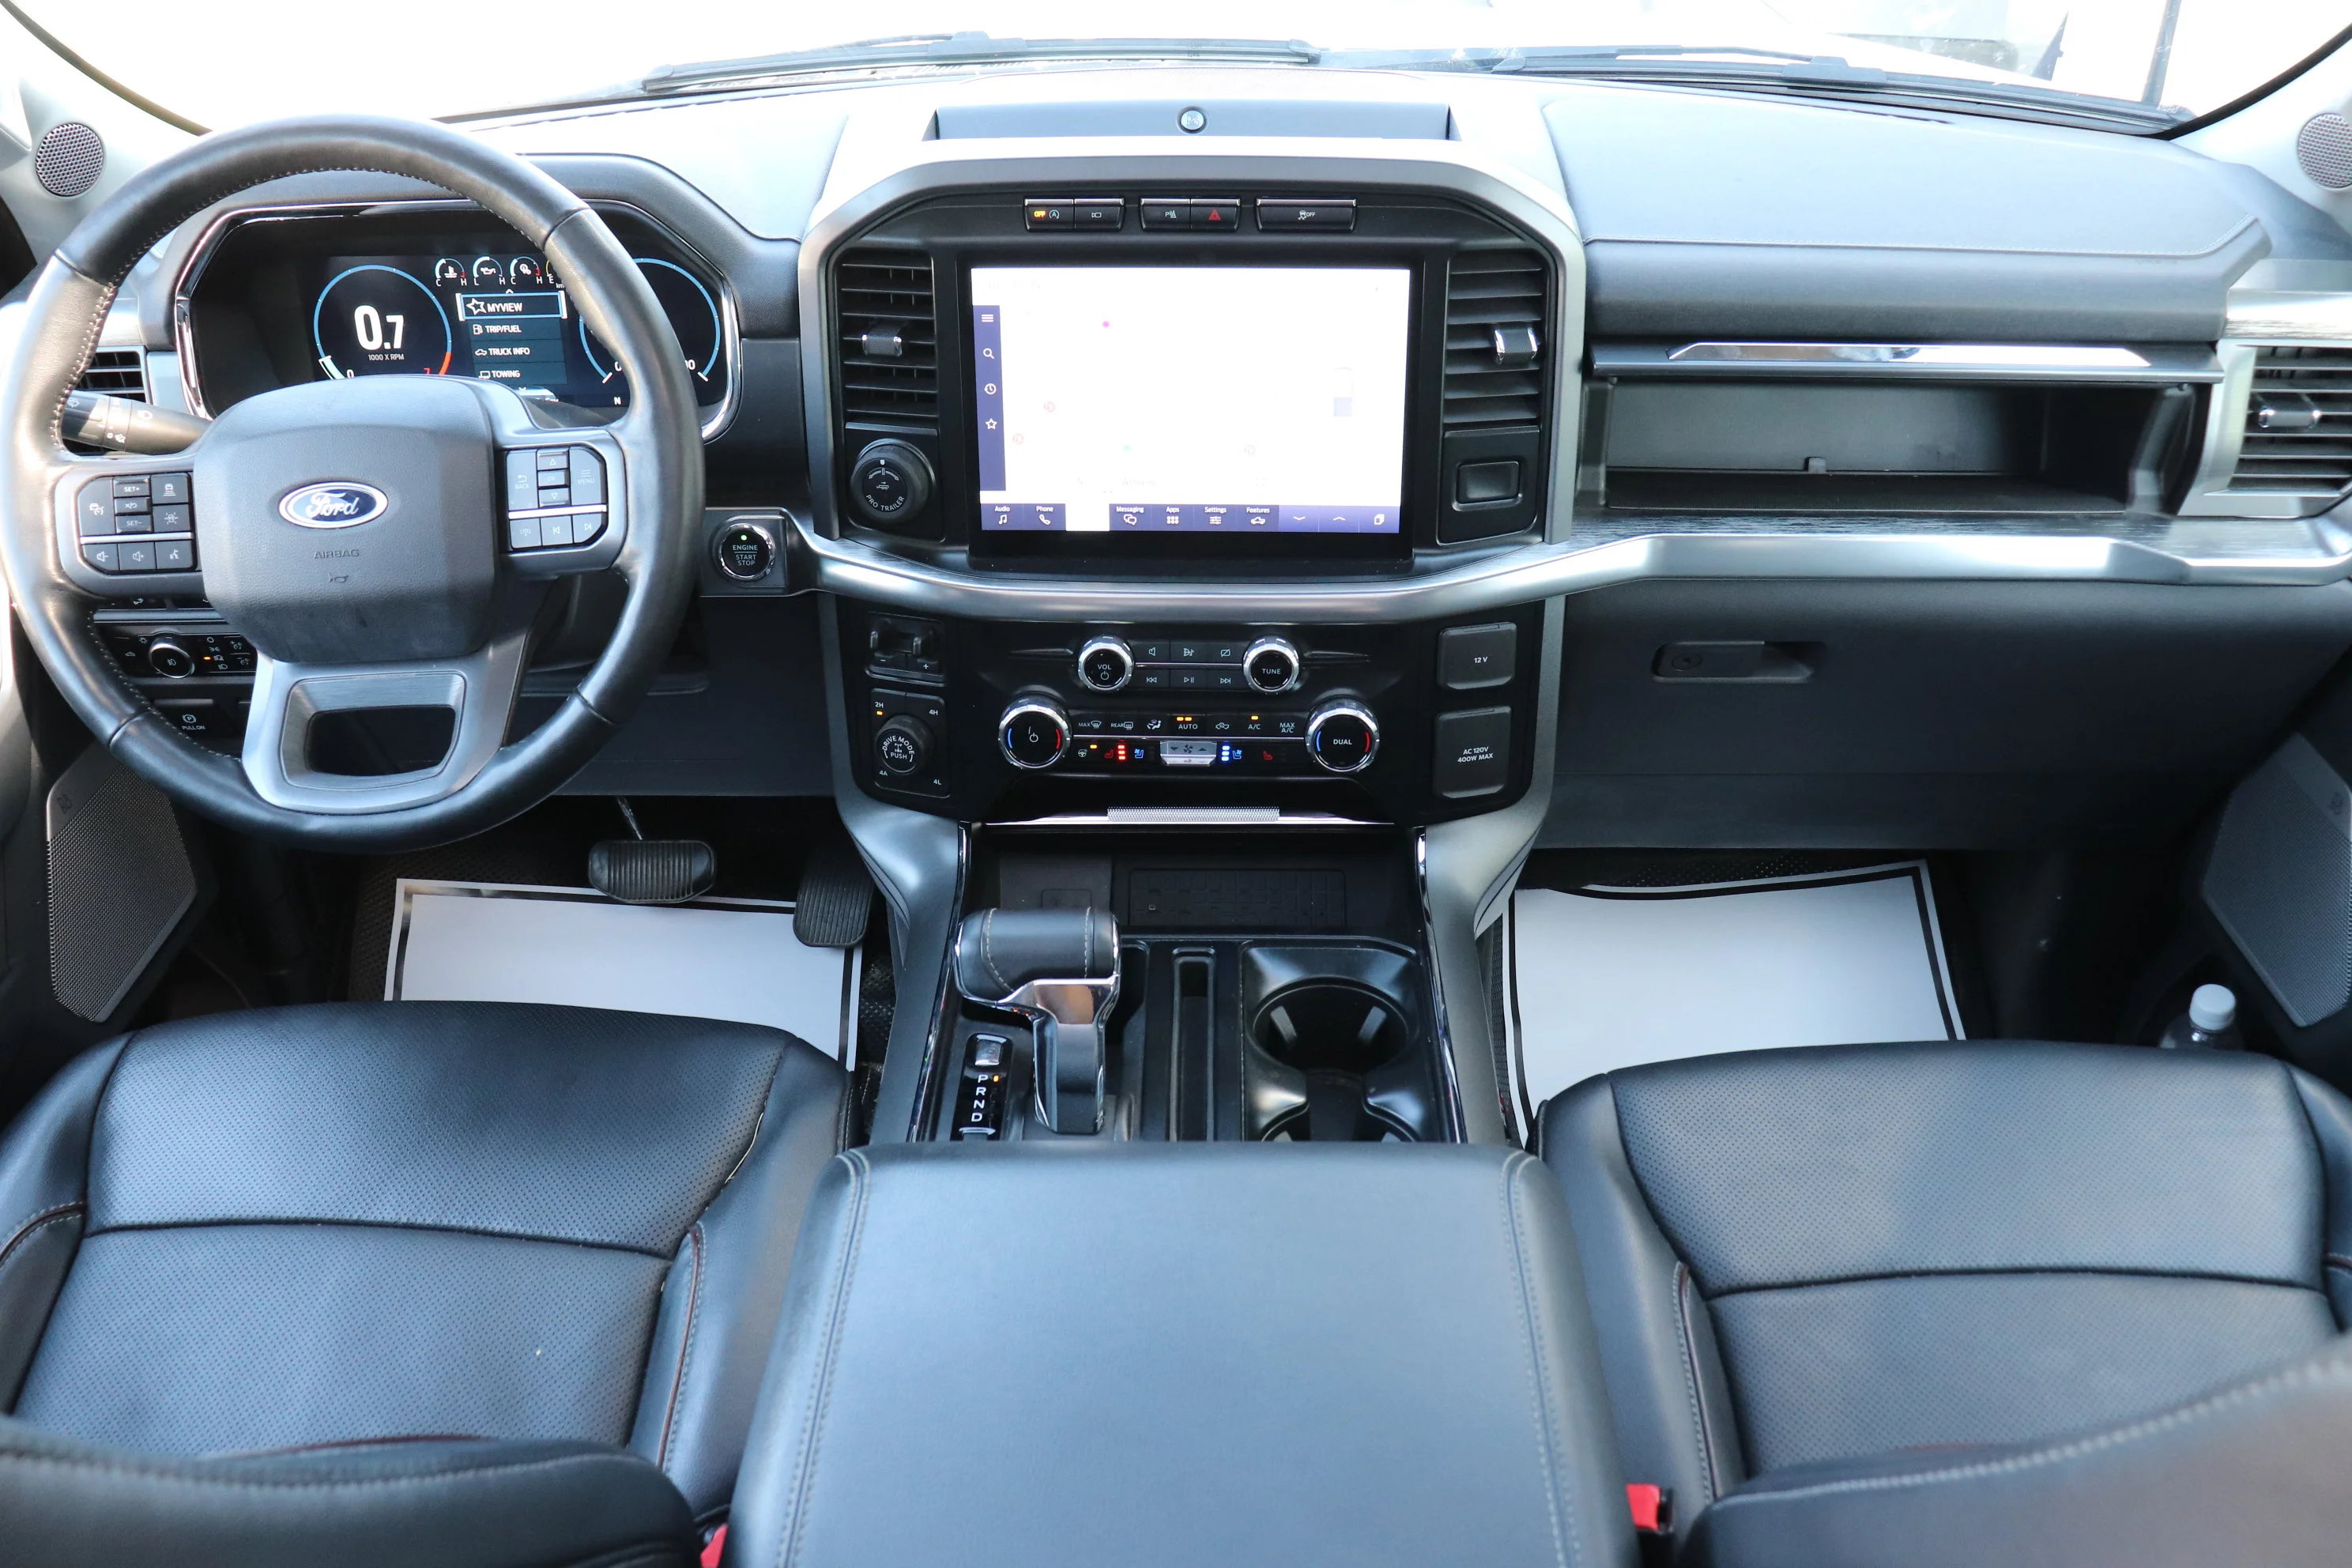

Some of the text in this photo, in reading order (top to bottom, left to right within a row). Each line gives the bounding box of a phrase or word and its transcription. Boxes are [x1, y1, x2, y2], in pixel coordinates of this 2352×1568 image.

[487, 303, 523, 312] MYVIEW
[354, 305, 405, 350] 0.7
[306, 492, 360, 519] Ford
[866, 494, 905, 511] PRO TRAILER
[314, 549, 360, 559] AIRBAG
[882, 735, 915, 755] DRIVE MODE
[978, 1074, 988, 1083] P
[975, 1087, 987, 1095] R
[973, 1099, 985, 1109] N
[971, 1113, 983, 1122] D
